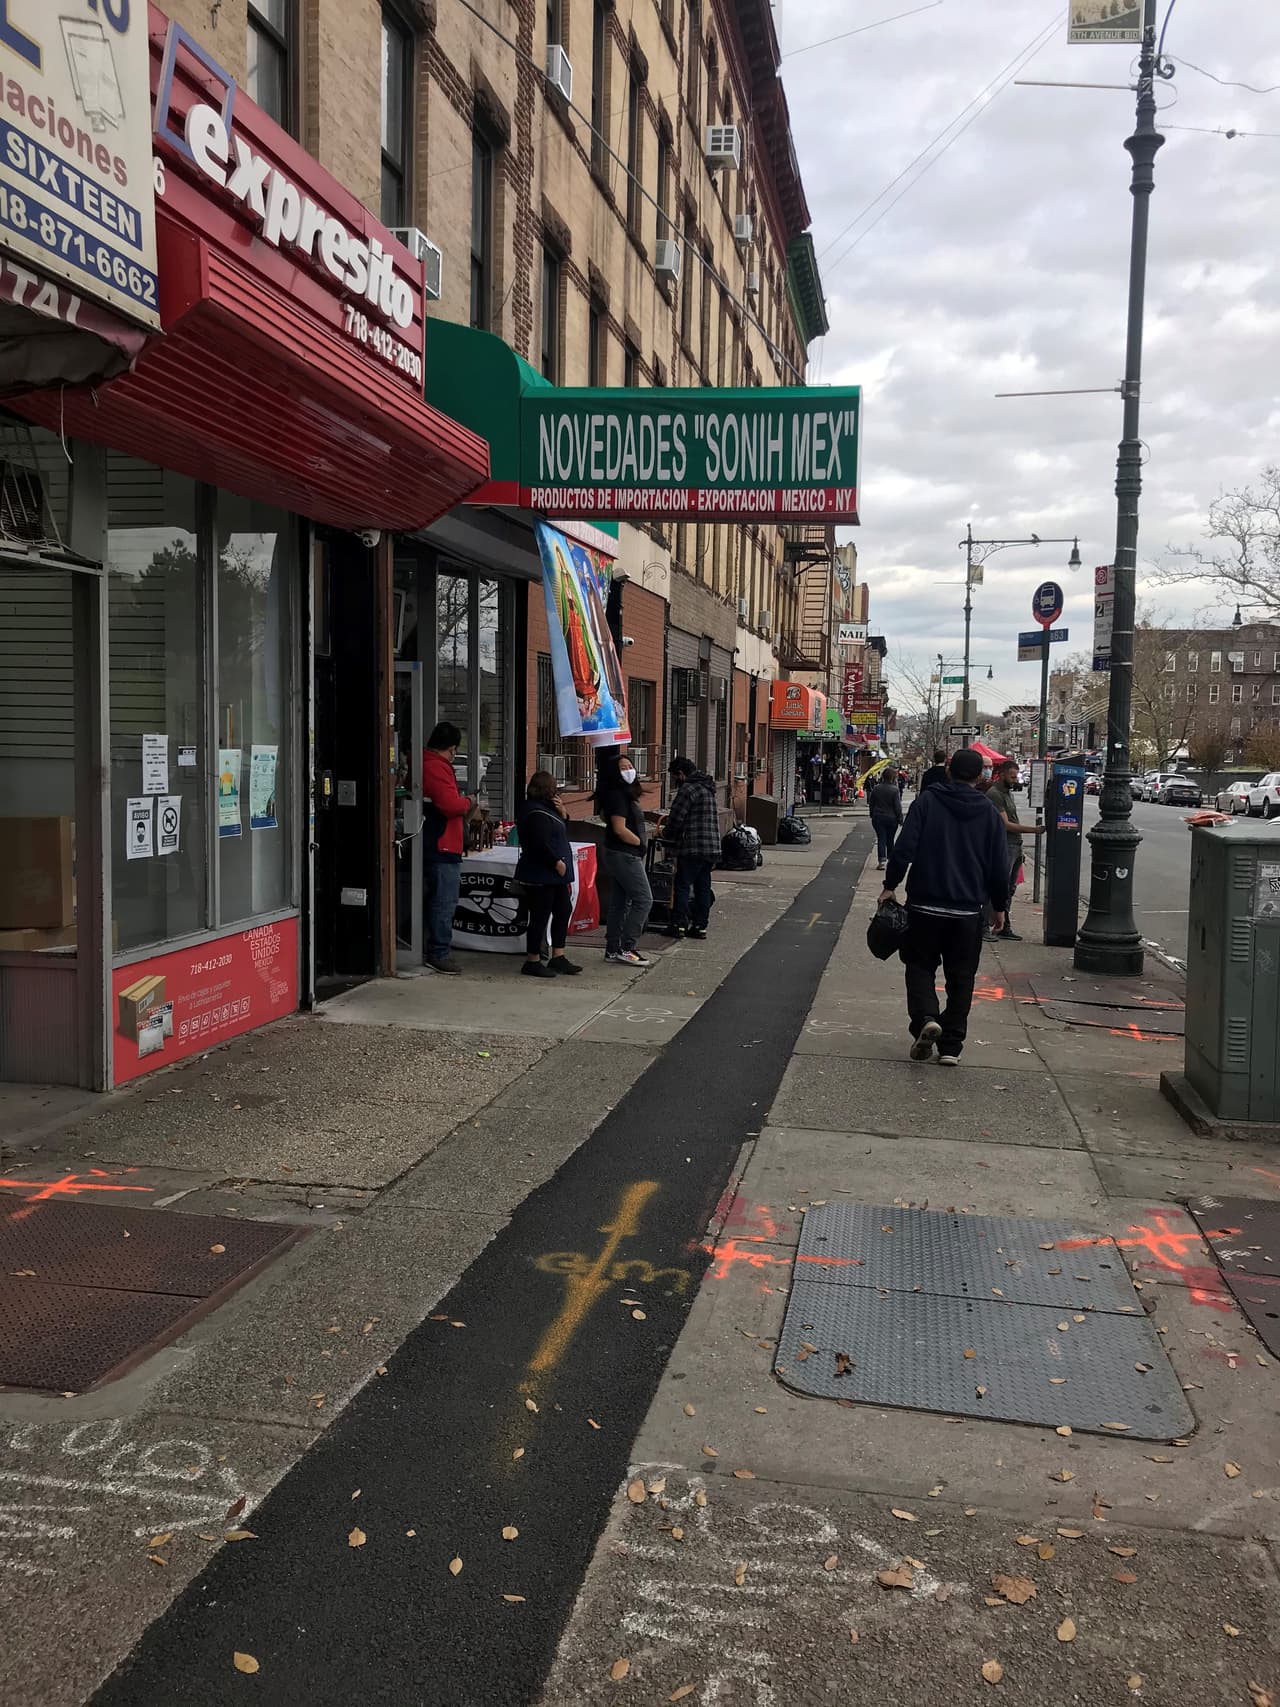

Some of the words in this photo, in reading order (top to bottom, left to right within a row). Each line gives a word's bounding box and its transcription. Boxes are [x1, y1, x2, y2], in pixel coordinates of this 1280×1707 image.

[1071, 31, 1087, 39] 5TH
[1090, 31, 1122, 39] AVENUE
[1125, 31, 1138, 39] BID
[0, 72, 128, 187] aciones
[6, 131, 137, 243] SIXTEEN
[185, 103, 414, 329] expresito
[344, 303, 422, 382] 718-412-2030
[539, 413, 687, 482] NOVEDADES
[694, 412, 784, 482] "SONIH
[791, 410, 855, 481] MEX"
[531, 488, 594, 509] PRODUCTOS
[598, 488, 611, 509] DE
[615, 488, 688, 510] IMPORTACION
[698, 488, 775, 511] EXPORTACION
[782, 489, 826, 511] MEXICO
[836, 489, 852, 511] NY
[839, 630, 865, 639] NAIL
[460, 874, 495, 886] ECHO
[242, 924, 274, 942] CANADA
[453, 919, 518, 934] MEXICO
[250, 932, 281, 951] ESTADOS
[251, 943, 280, 961] UNIDOS
[190, 953, 233, 976] 718-412-2030
